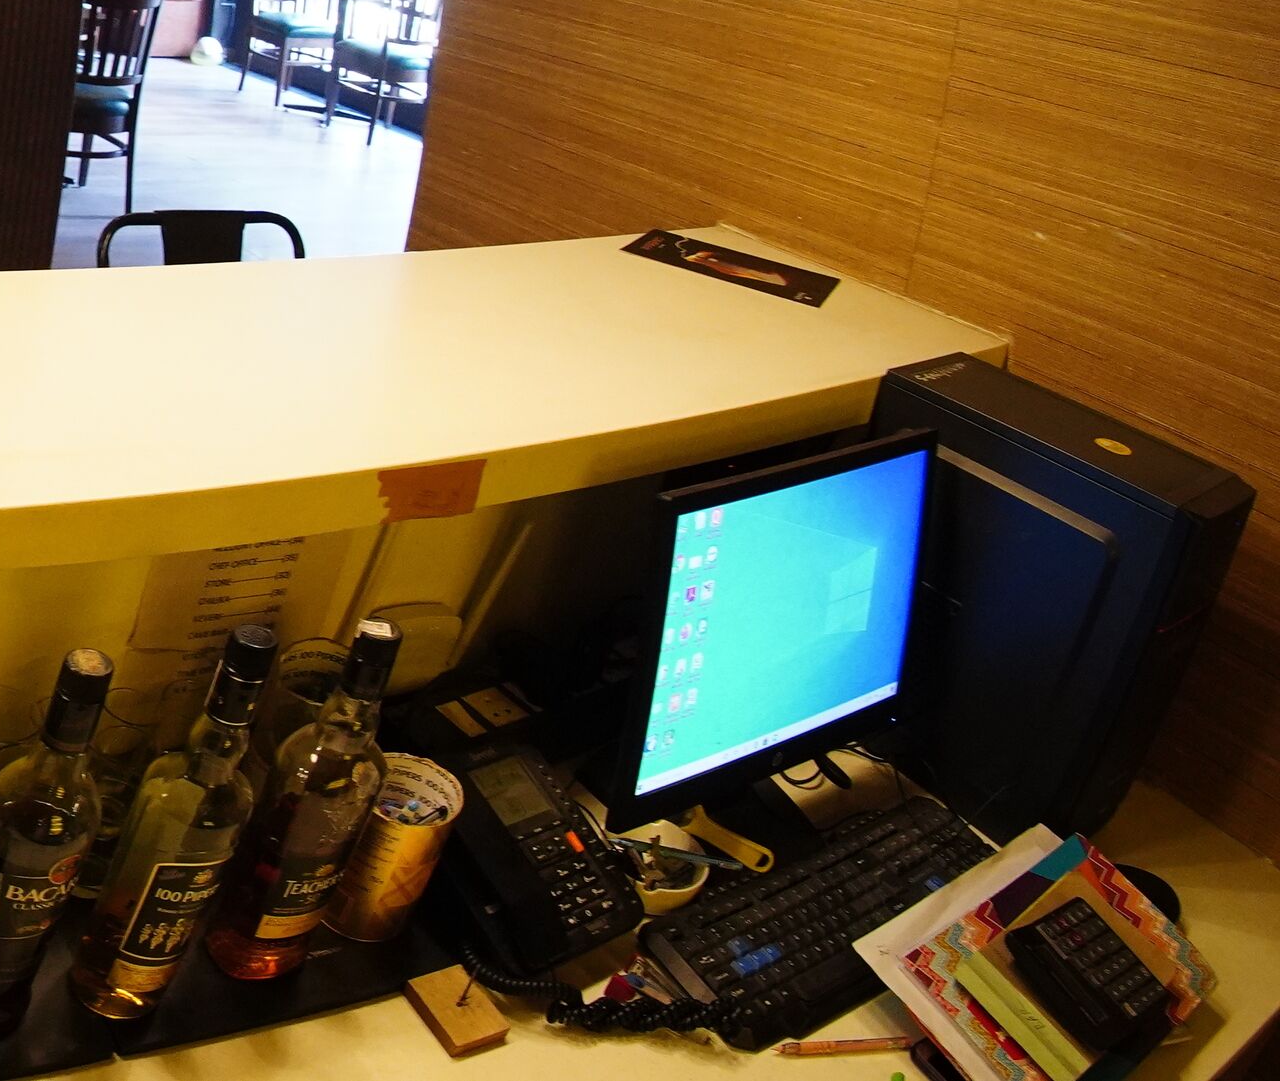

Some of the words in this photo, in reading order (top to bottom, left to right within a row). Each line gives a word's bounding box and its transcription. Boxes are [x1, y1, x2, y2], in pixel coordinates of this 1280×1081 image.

[392, 767, 423, 782] PIPERS
[386, 783, 416, 798] PIPERS
[155, 887, 183, 902] 100
